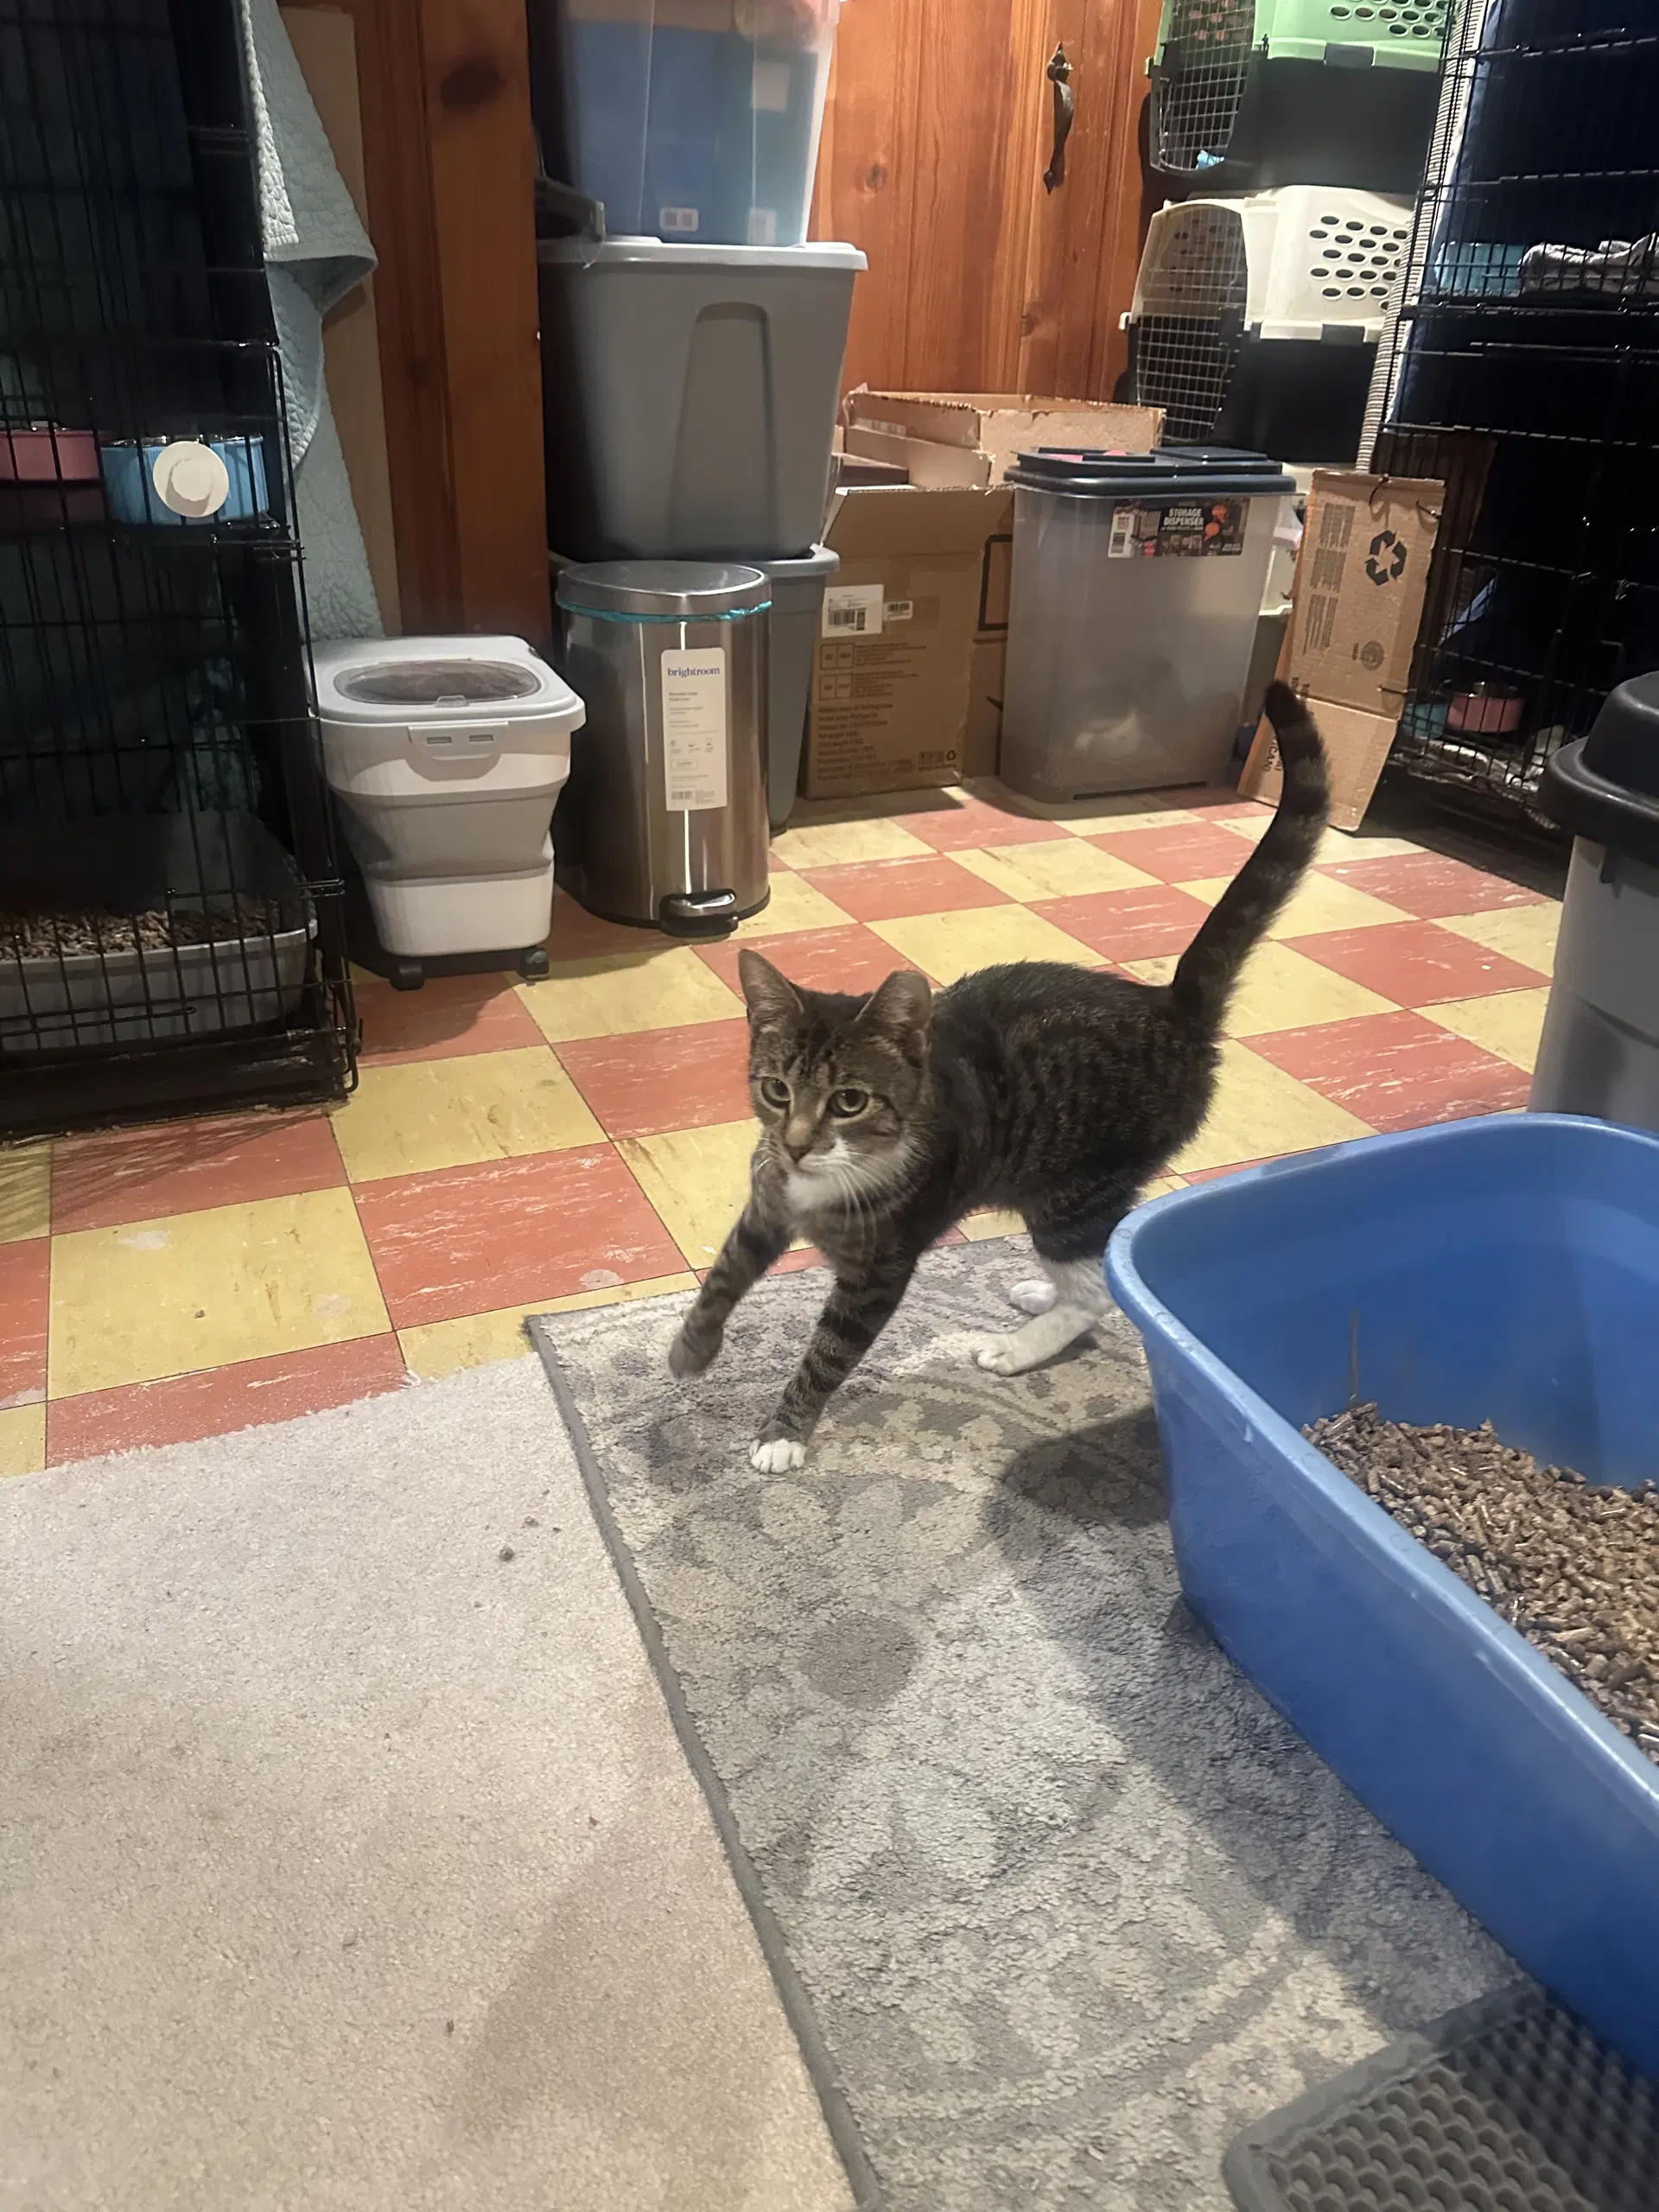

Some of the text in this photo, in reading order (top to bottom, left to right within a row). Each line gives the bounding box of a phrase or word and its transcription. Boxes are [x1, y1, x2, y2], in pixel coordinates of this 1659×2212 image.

[1168, 507, 1202, 517] STORAGE
[1163, 517, 1205, 526] DISPENSER
[667, 667, 721, 678] brightroom
